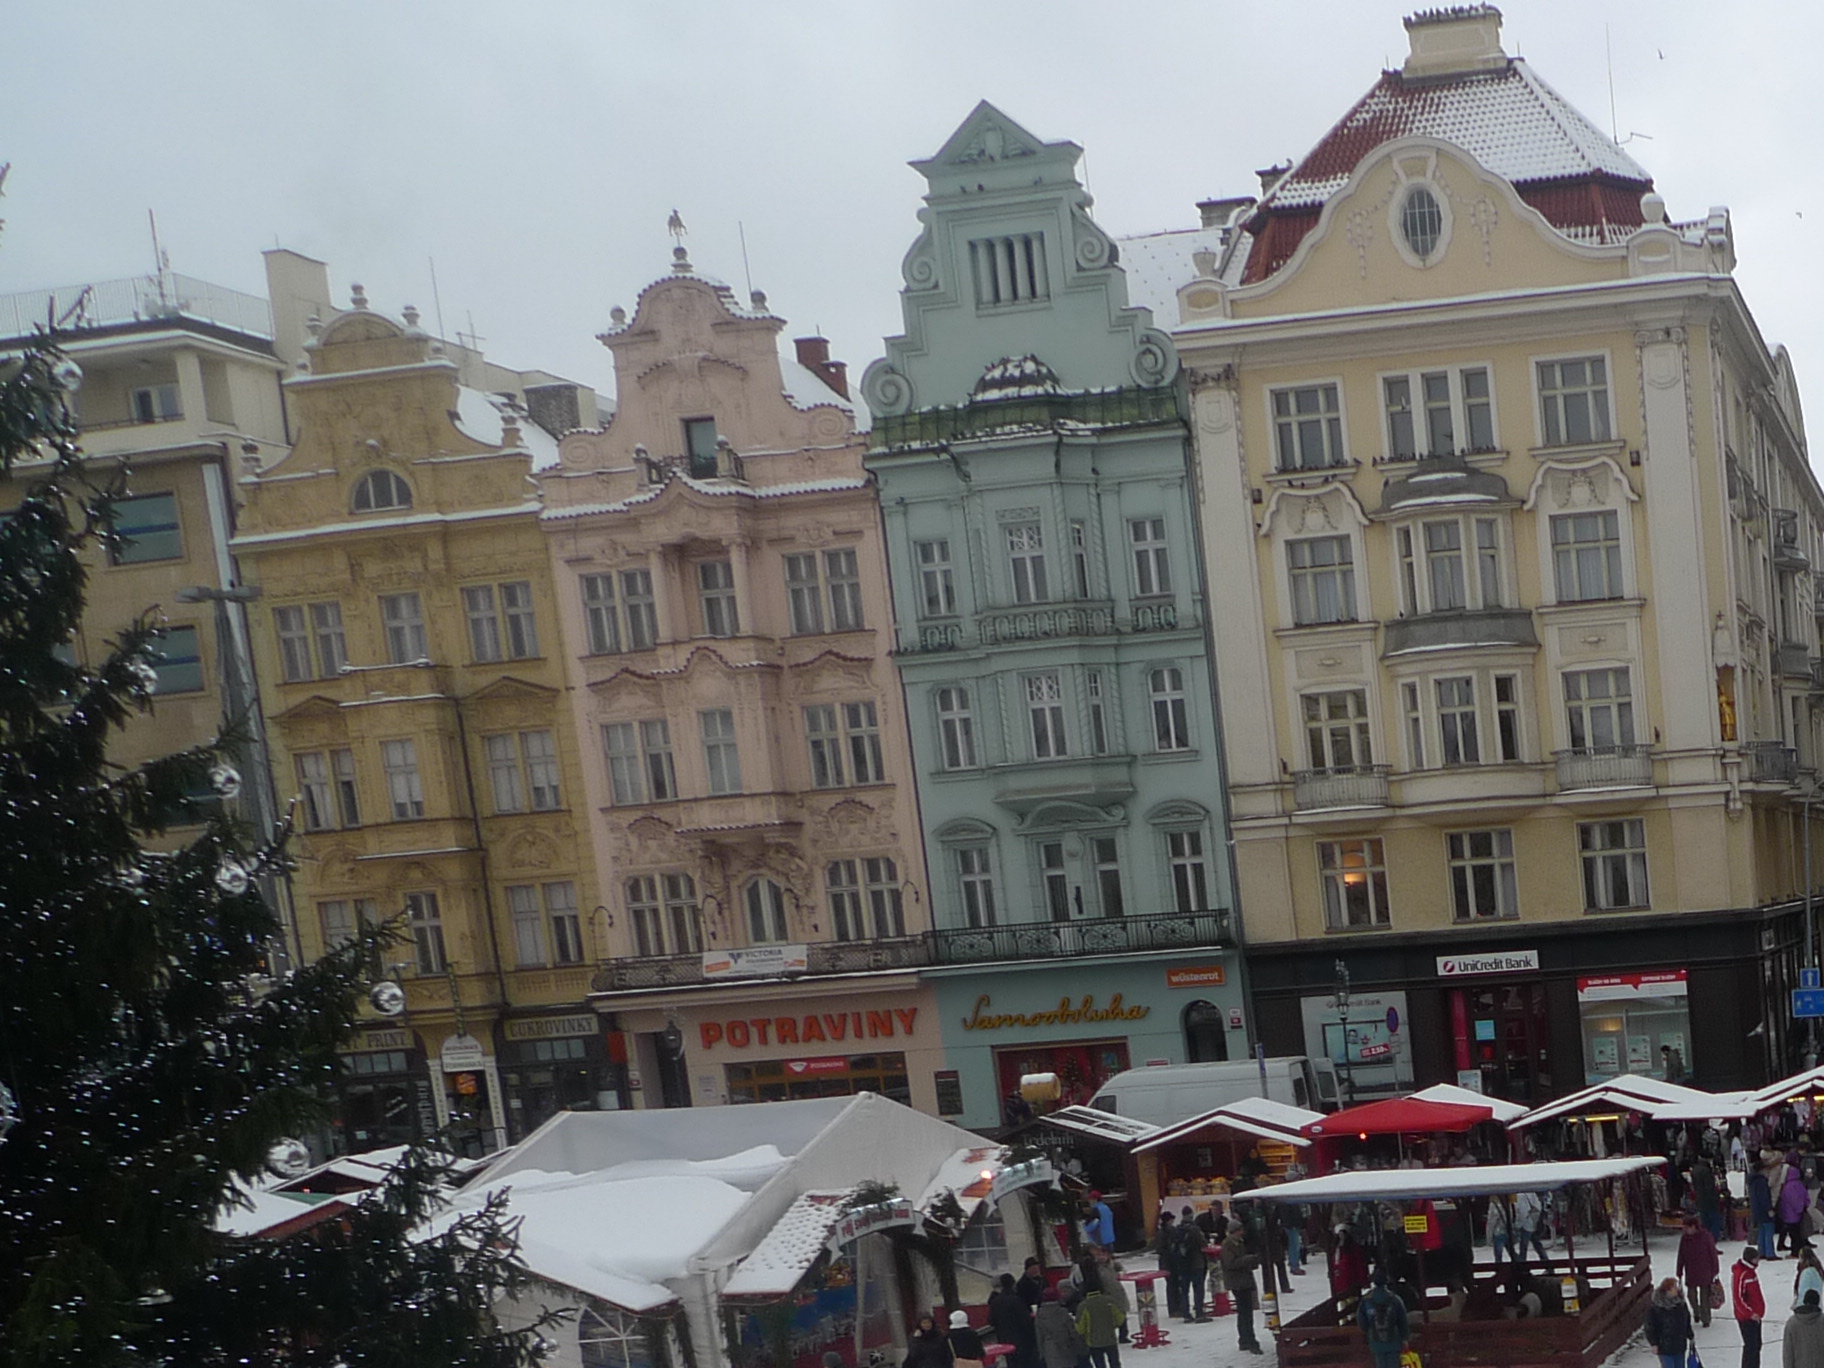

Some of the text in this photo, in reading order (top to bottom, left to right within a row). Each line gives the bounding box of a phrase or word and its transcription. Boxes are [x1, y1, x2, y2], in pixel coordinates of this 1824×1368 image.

[1458, 955, 1533, 972] UniCredit Bank
[1170, 970, 1219, 983] wüstenrot
[963, 993, 1149, 1030] Samoobsluha
[509, 1013, 594, 1038] CUKROVINKY
[700, 1007, 918, 1049] POTRAVINY
[367, 1031, 406, 1049] PRINT
